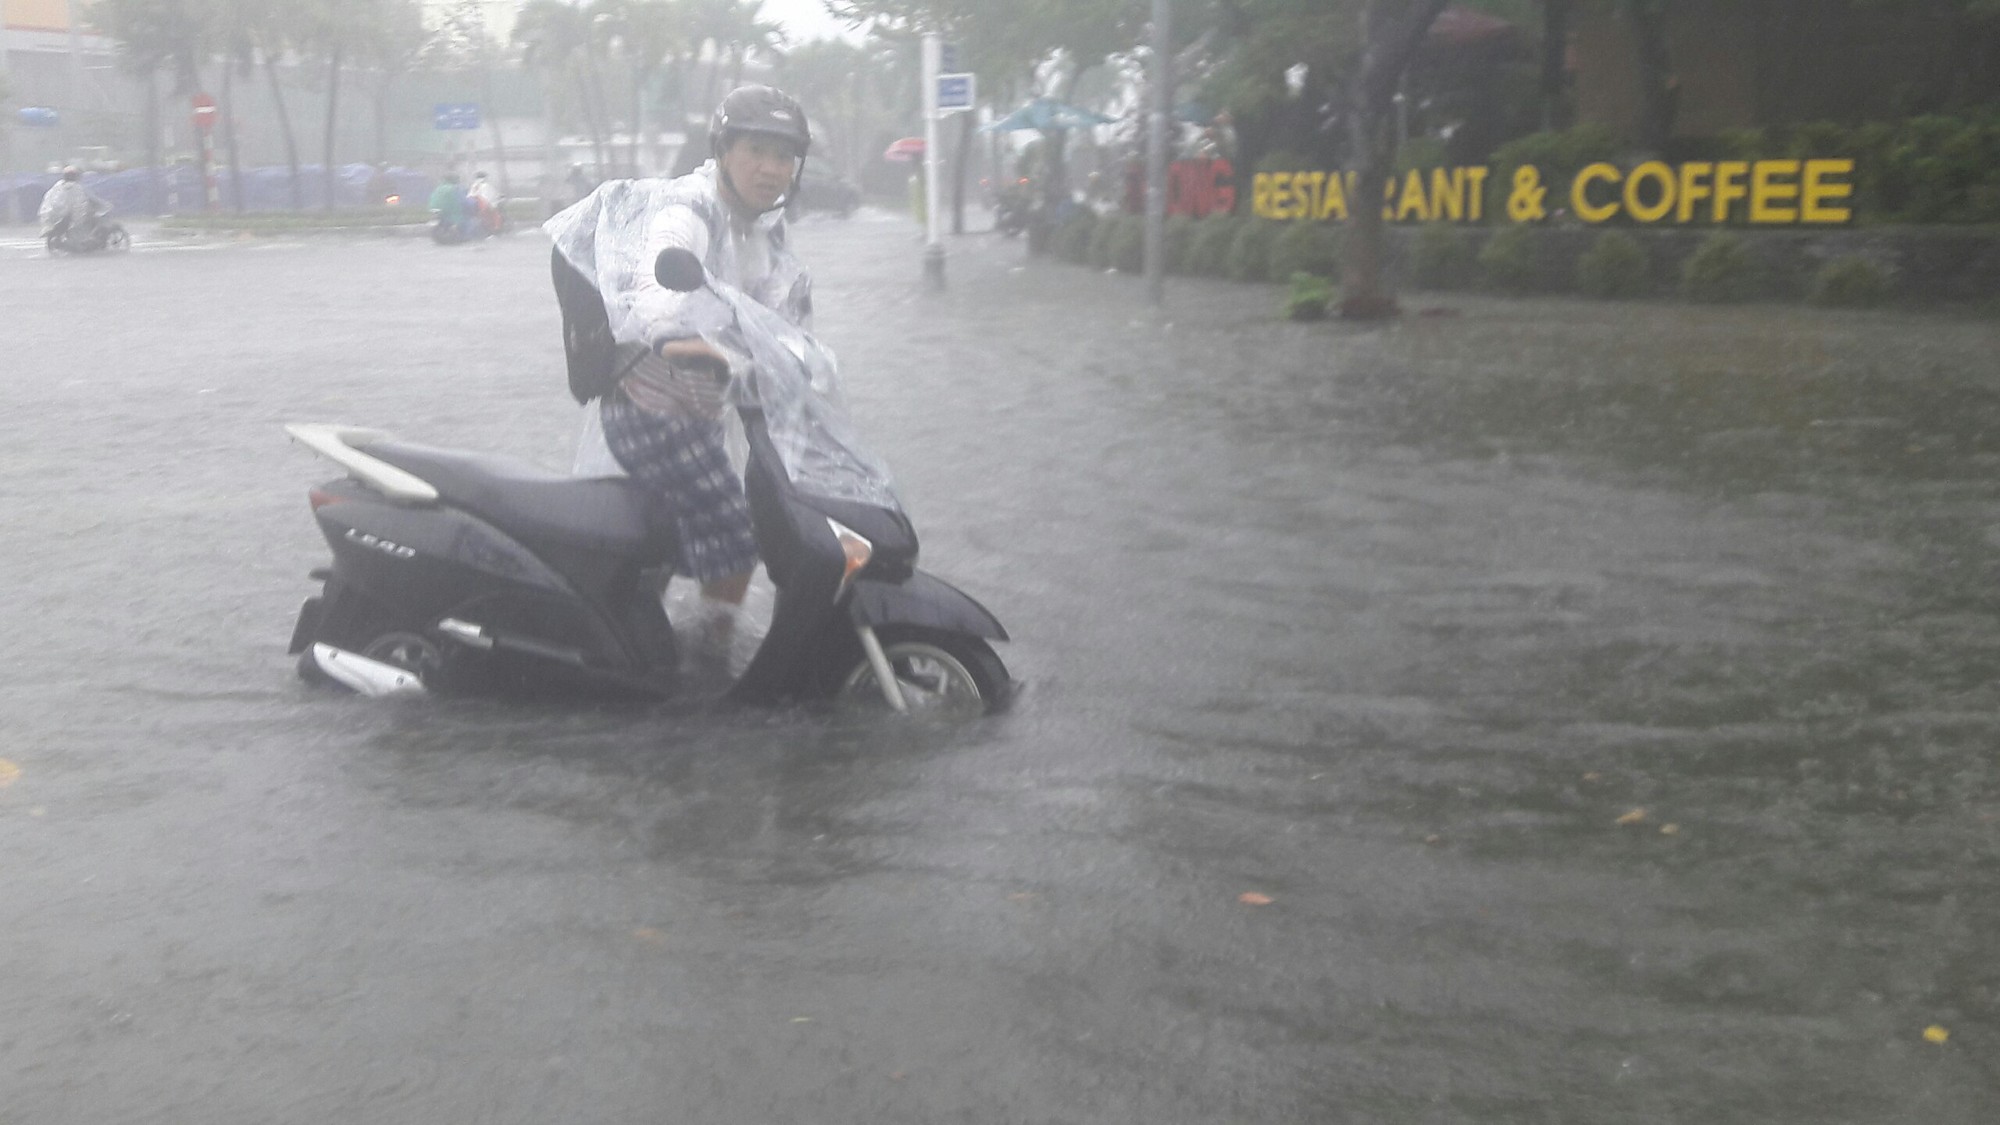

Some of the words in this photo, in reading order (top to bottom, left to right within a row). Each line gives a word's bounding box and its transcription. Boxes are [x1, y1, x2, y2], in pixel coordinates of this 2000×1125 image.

[1252, 166, 1489, 222] RESTAANT
[1507, 164, 1548, 222] &
[1571, 159, 1854, 223] COFFEE
[344, 528, 417, 559] LEAD
